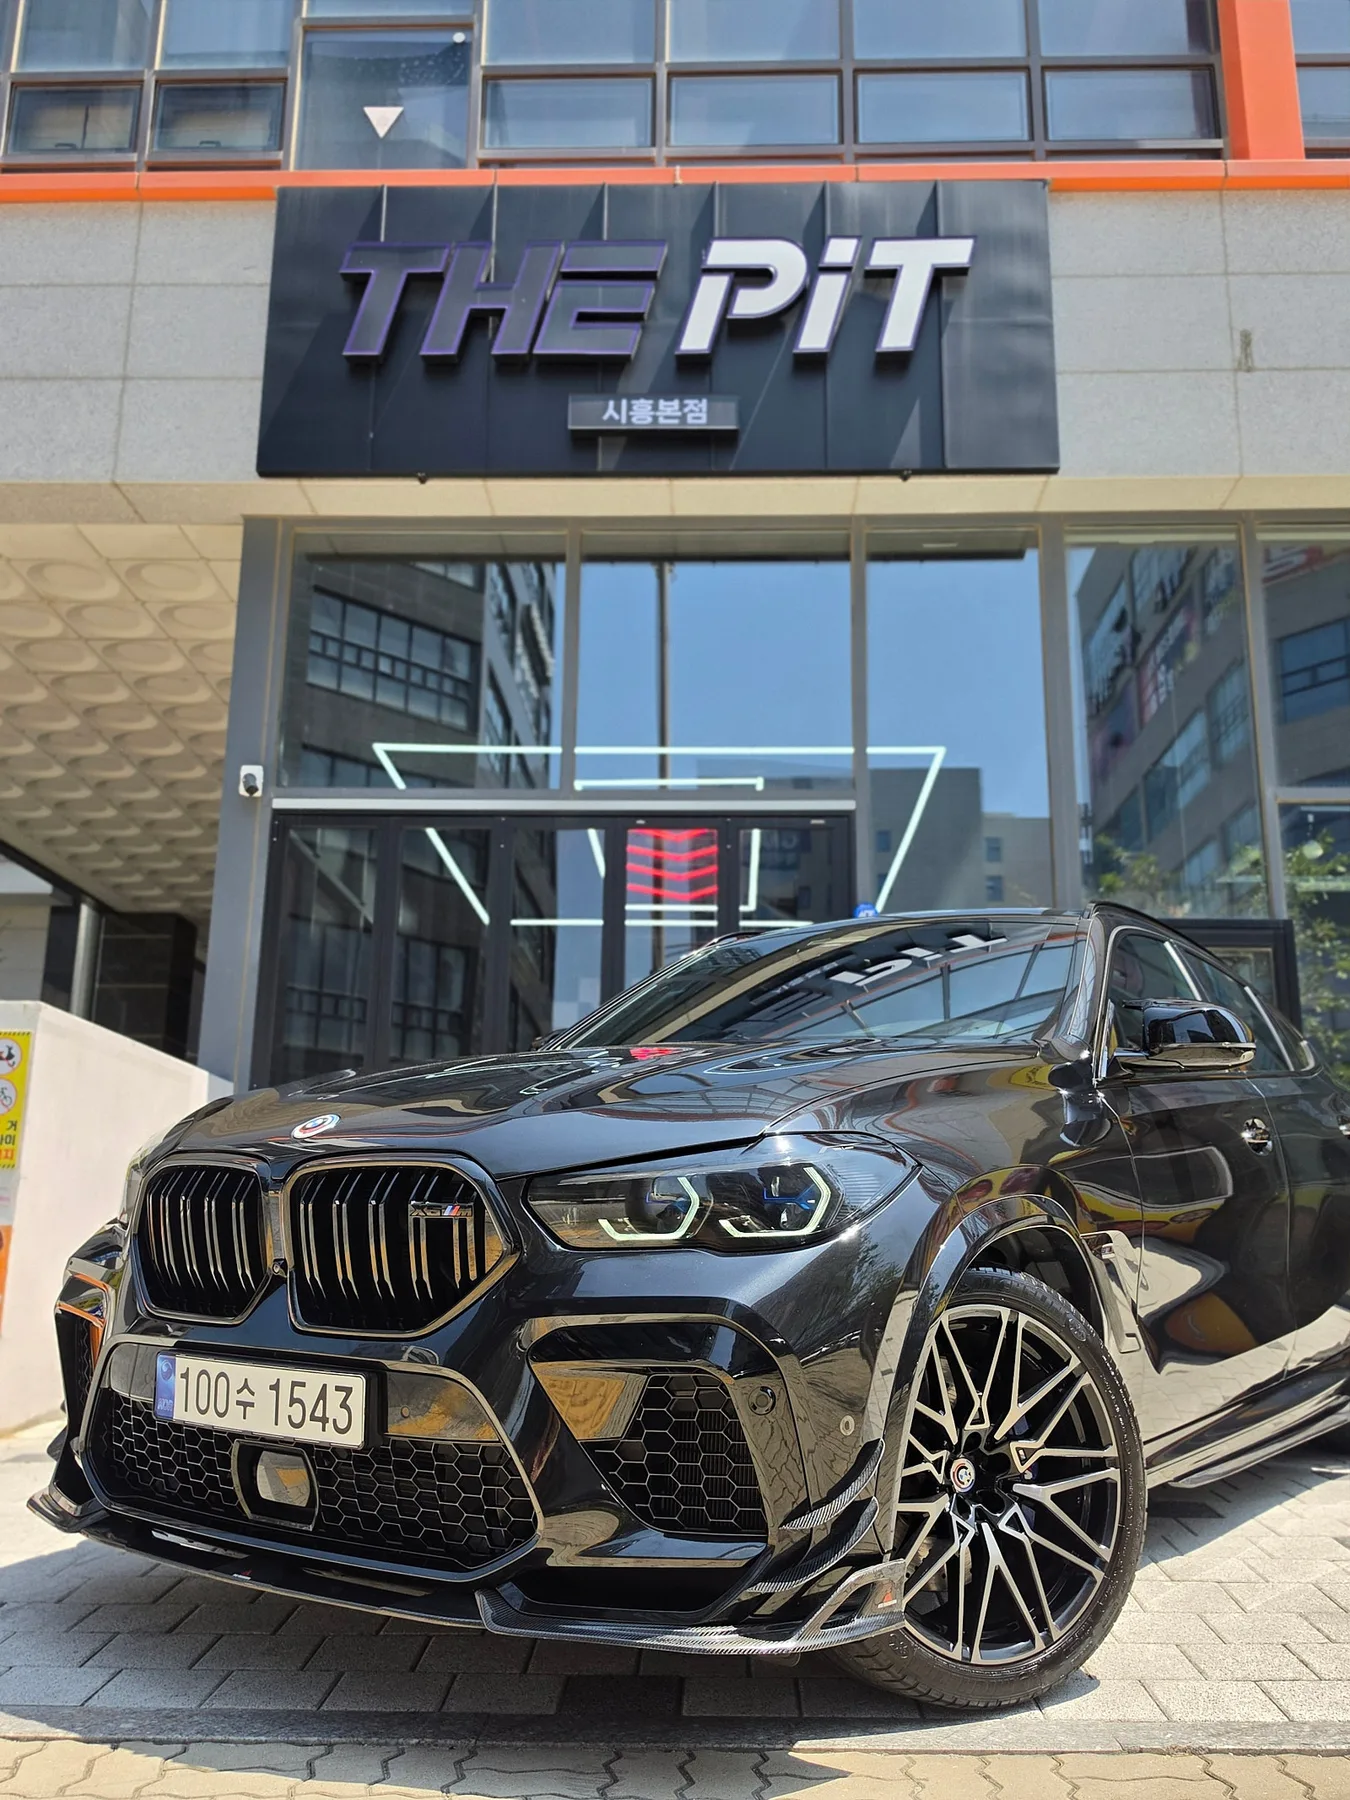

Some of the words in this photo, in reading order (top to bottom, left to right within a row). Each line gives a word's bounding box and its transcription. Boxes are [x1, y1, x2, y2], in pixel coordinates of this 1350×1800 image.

[340, 239, 669, 360] THE
[602, 397, 708, 425] 시흥본점
[180, 1366, 255, 1420] 100수
[269, 1377, 354, 1435] 1543
